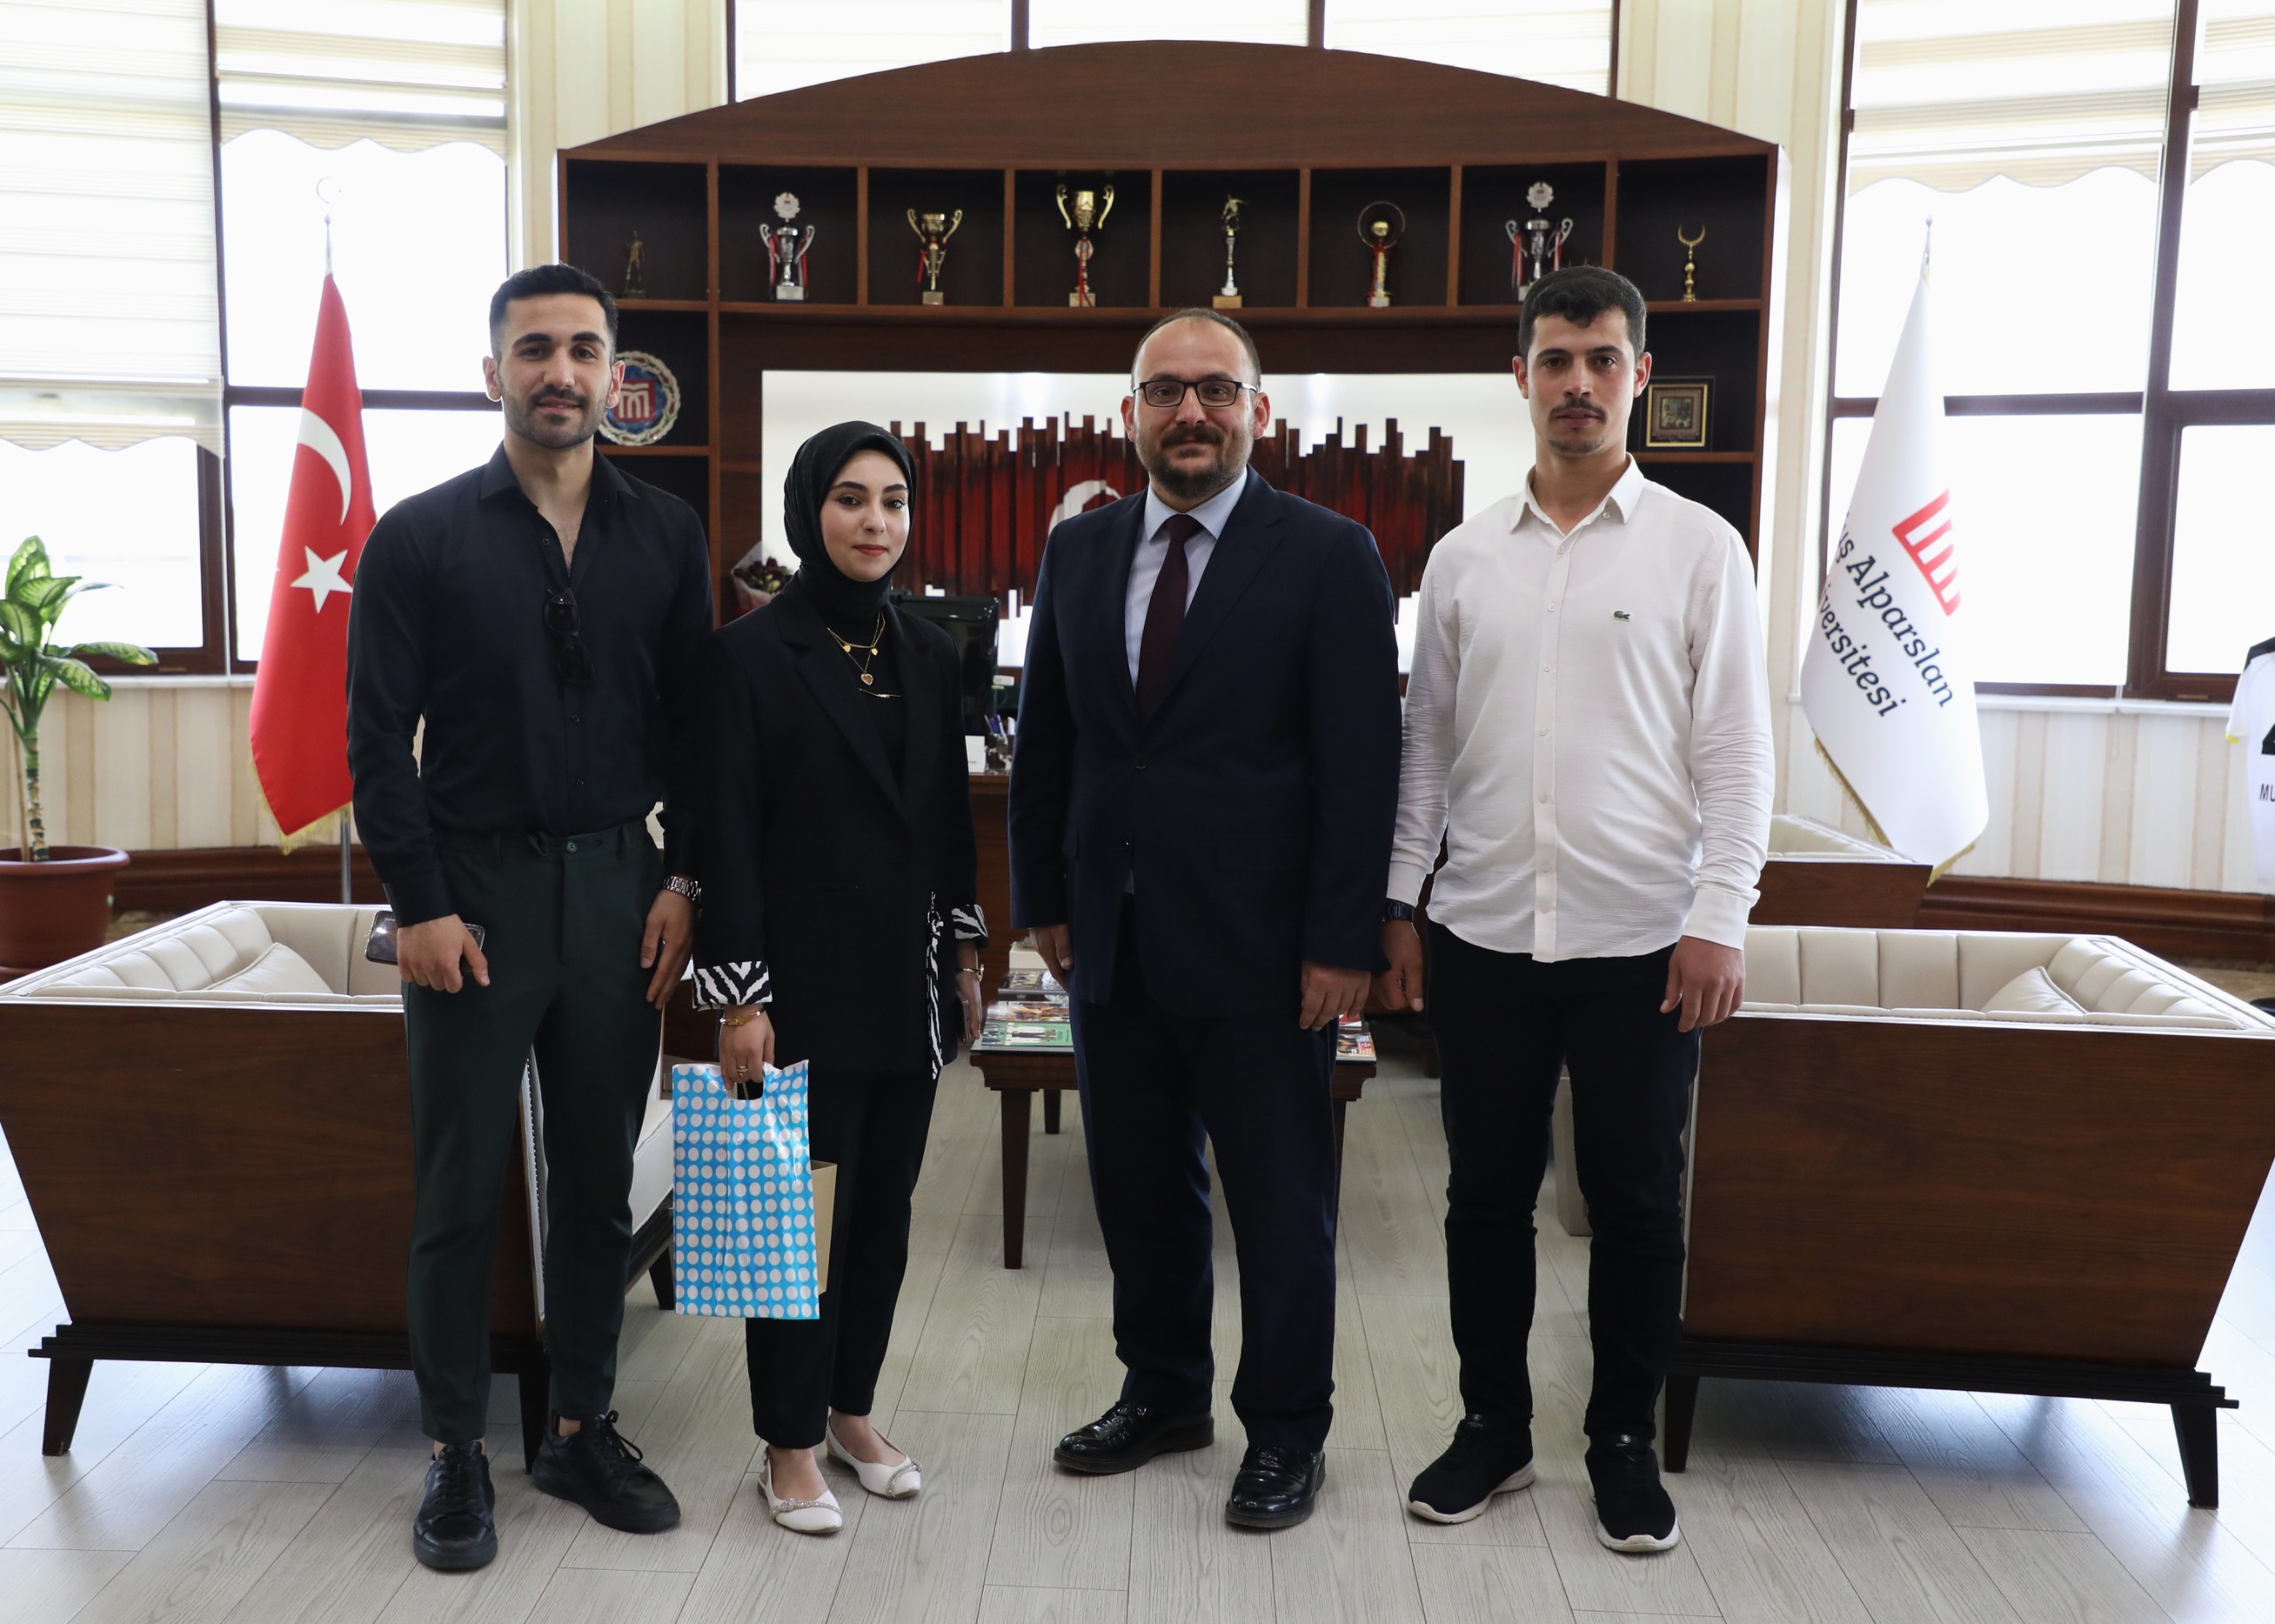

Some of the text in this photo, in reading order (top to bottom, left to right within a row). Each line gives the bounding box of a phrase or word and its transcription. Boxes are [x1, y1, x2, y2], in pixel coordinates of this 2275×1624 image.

[1819, 592, 1907, 717] versitesi
[1846, 554, 1953, 708] Alparslan
[2260, 784, 2275, 802] MU
